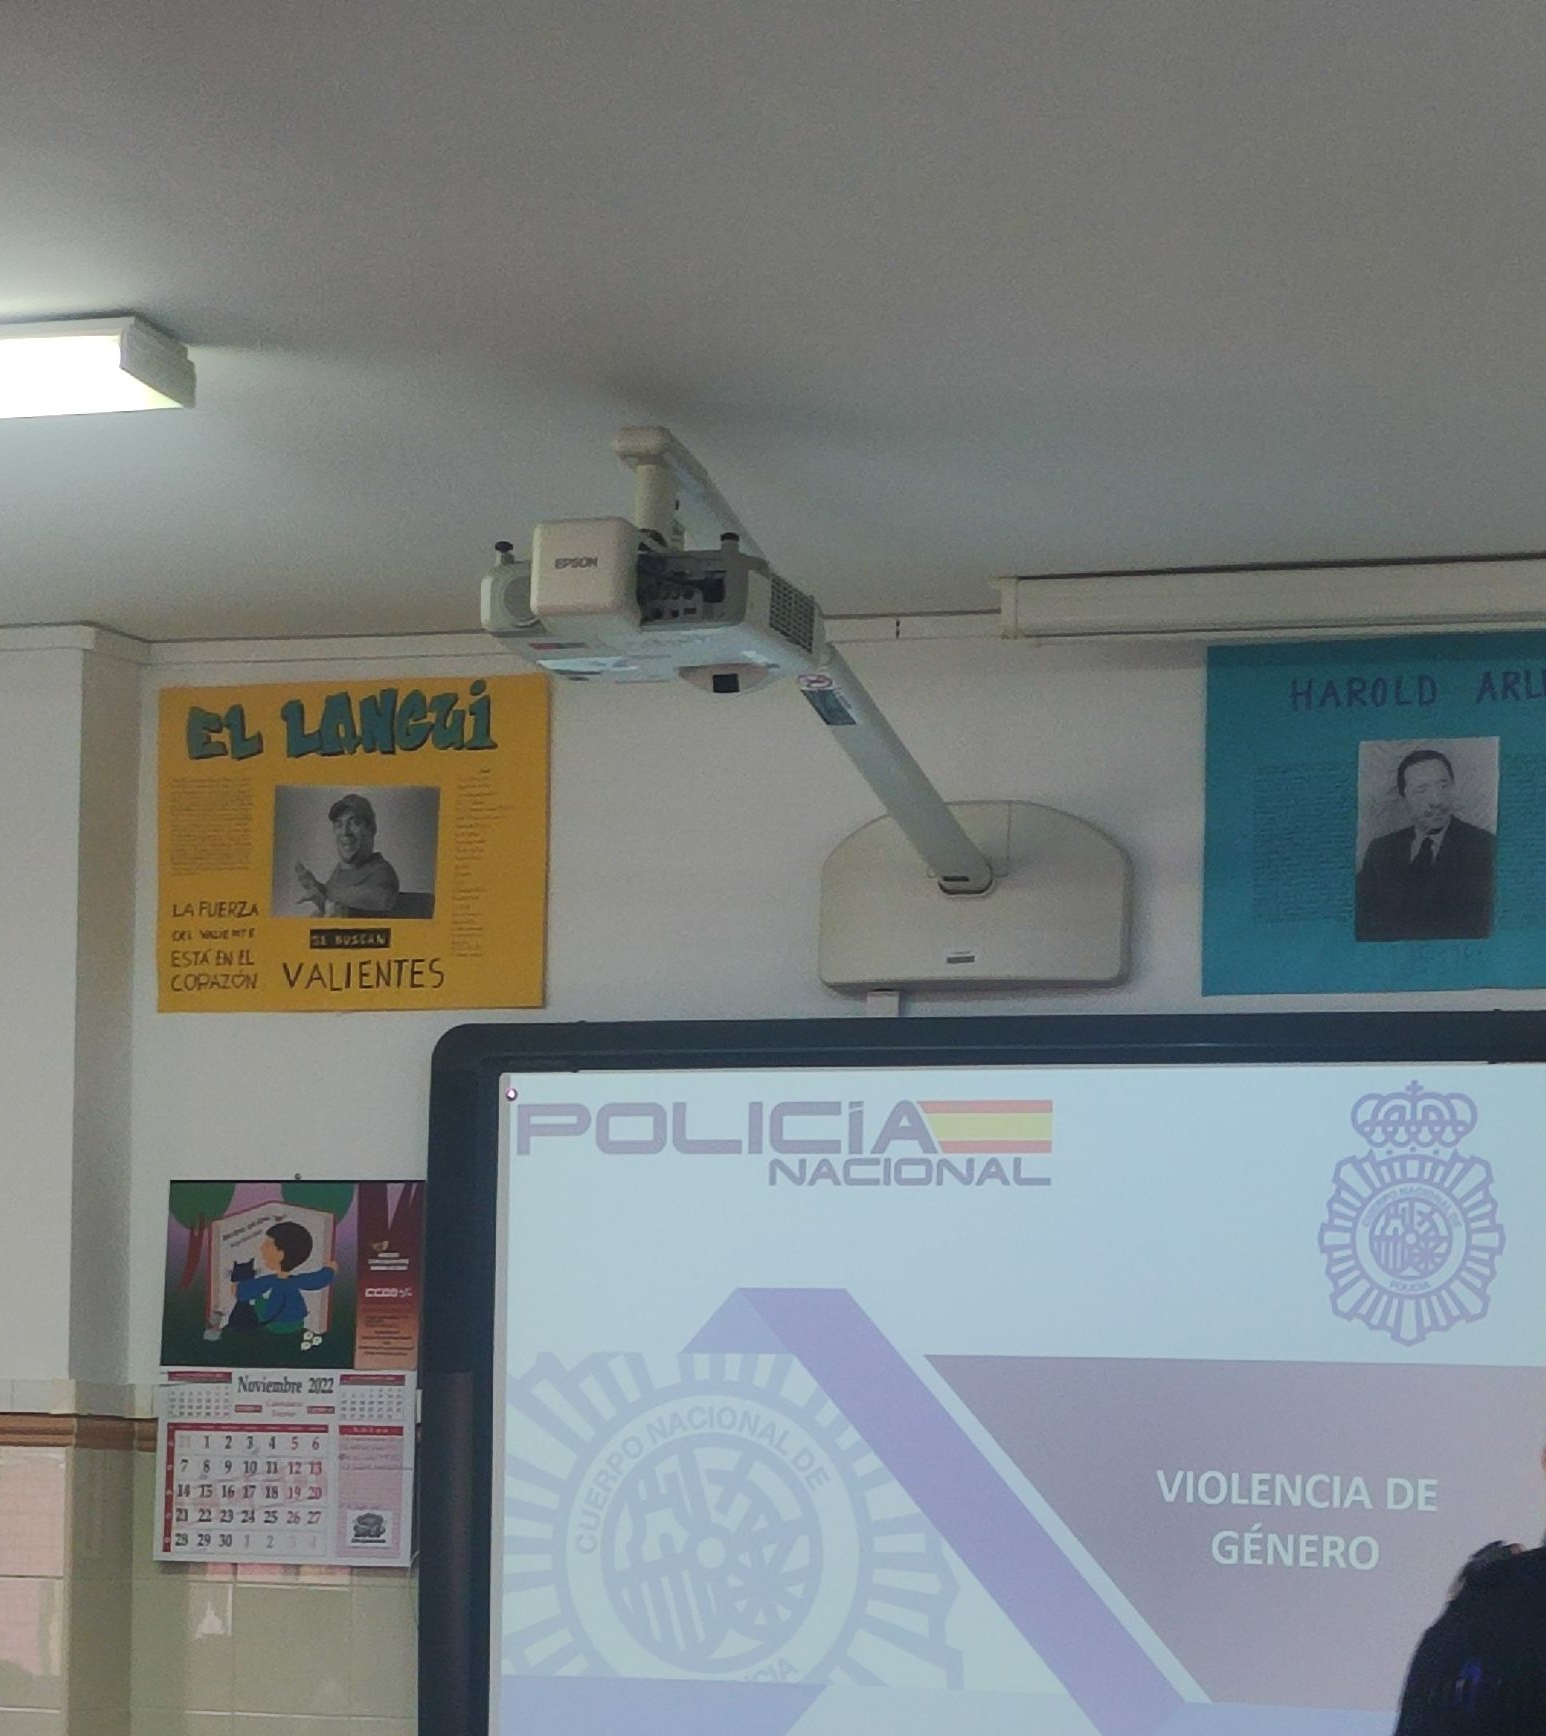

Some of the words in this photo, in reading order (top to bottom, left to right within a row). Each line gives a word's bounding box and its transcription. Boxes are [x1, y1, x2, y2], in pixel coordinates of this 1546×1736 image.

[555, 557, 598, 569] EPSON
[1288, 675, 1438, 711] HAROLD
[186, 704, 264, 760] EL
[172, 903, 194, 917] LA
[199, 900, 259, 917] FUERZA
[335, 932, 387, 946] BUSCAN
[171, 949, 210, 968] ESTÁ
[216, 951, 233, 966] EN
[239, 949, 255, 966] EL
[171, 970, 258, 992] CORAZÓN
[282, 957, 445, 992] VALIENTES
[516, 1099, 939, 1156] POLICÍA
[768, 1156, 1052, 1187] NACIONAL
[237, 1376, 303, 1395] Noviembre
[307, 1377, 334, 1394] 2022
[204, 1436, 210, 1448] 1
[225, 1436, 232, 1449] 2
[246, 1436, 253, 1449] 3
[269, 1436, 276, 1449] 4
[291, 1436, 299, 1449] 5
[312, 1436, 319, 1450] 6
[181, 1460, 188, 1472] 7
[203, 1460, 210, 1472] 8
[225, 1460, 232, 1472] 9
[244, 1461, 257, 1473] 10
[266, 1461, 278, 1473] 11
[288, 1461, 301, 1474] 12
[310, 1461, 322, 1474] 13
[575, 1435, 644, 1555] CUERPO
[645, 1405, 790, 1456] NACIONAL
[790, 1447, 831, 1492] DE
[177, 1484, 190, 1497] 14
[199, 1484, 213, 1497] 15
[222, 1485, 234, 1498] 16
[242, 1485, 256, 1498] 17
[265, 1486, 278, 1499] 18
[289, 1486, 301, 1499] 19
[308, 1487, 322, 1500] 20
[1156, 1469, 1374, 1510] VIOLENCIA
[1386, 1477, 1438, 1512] DE
[176, 1509, 188, 1521] 21
[198, 1509, 211, 1522] 22
[220, 1509, 233, 1522] 23
[241, 1510, 255, 1523] 24
[264, 1510, 278, 1523] 25
[287, 1511, 300, 1524] 26
[307, 1511, 321, 1525] 27
[175, 1534, 188, 1546] 28
[197, 1534, 211, 1546] 29
[219, 1535, 232, 1547] 30
[266, 1536, 274, 1548] 2
[1211, 1523, 1380, 1571] GÉNERO
